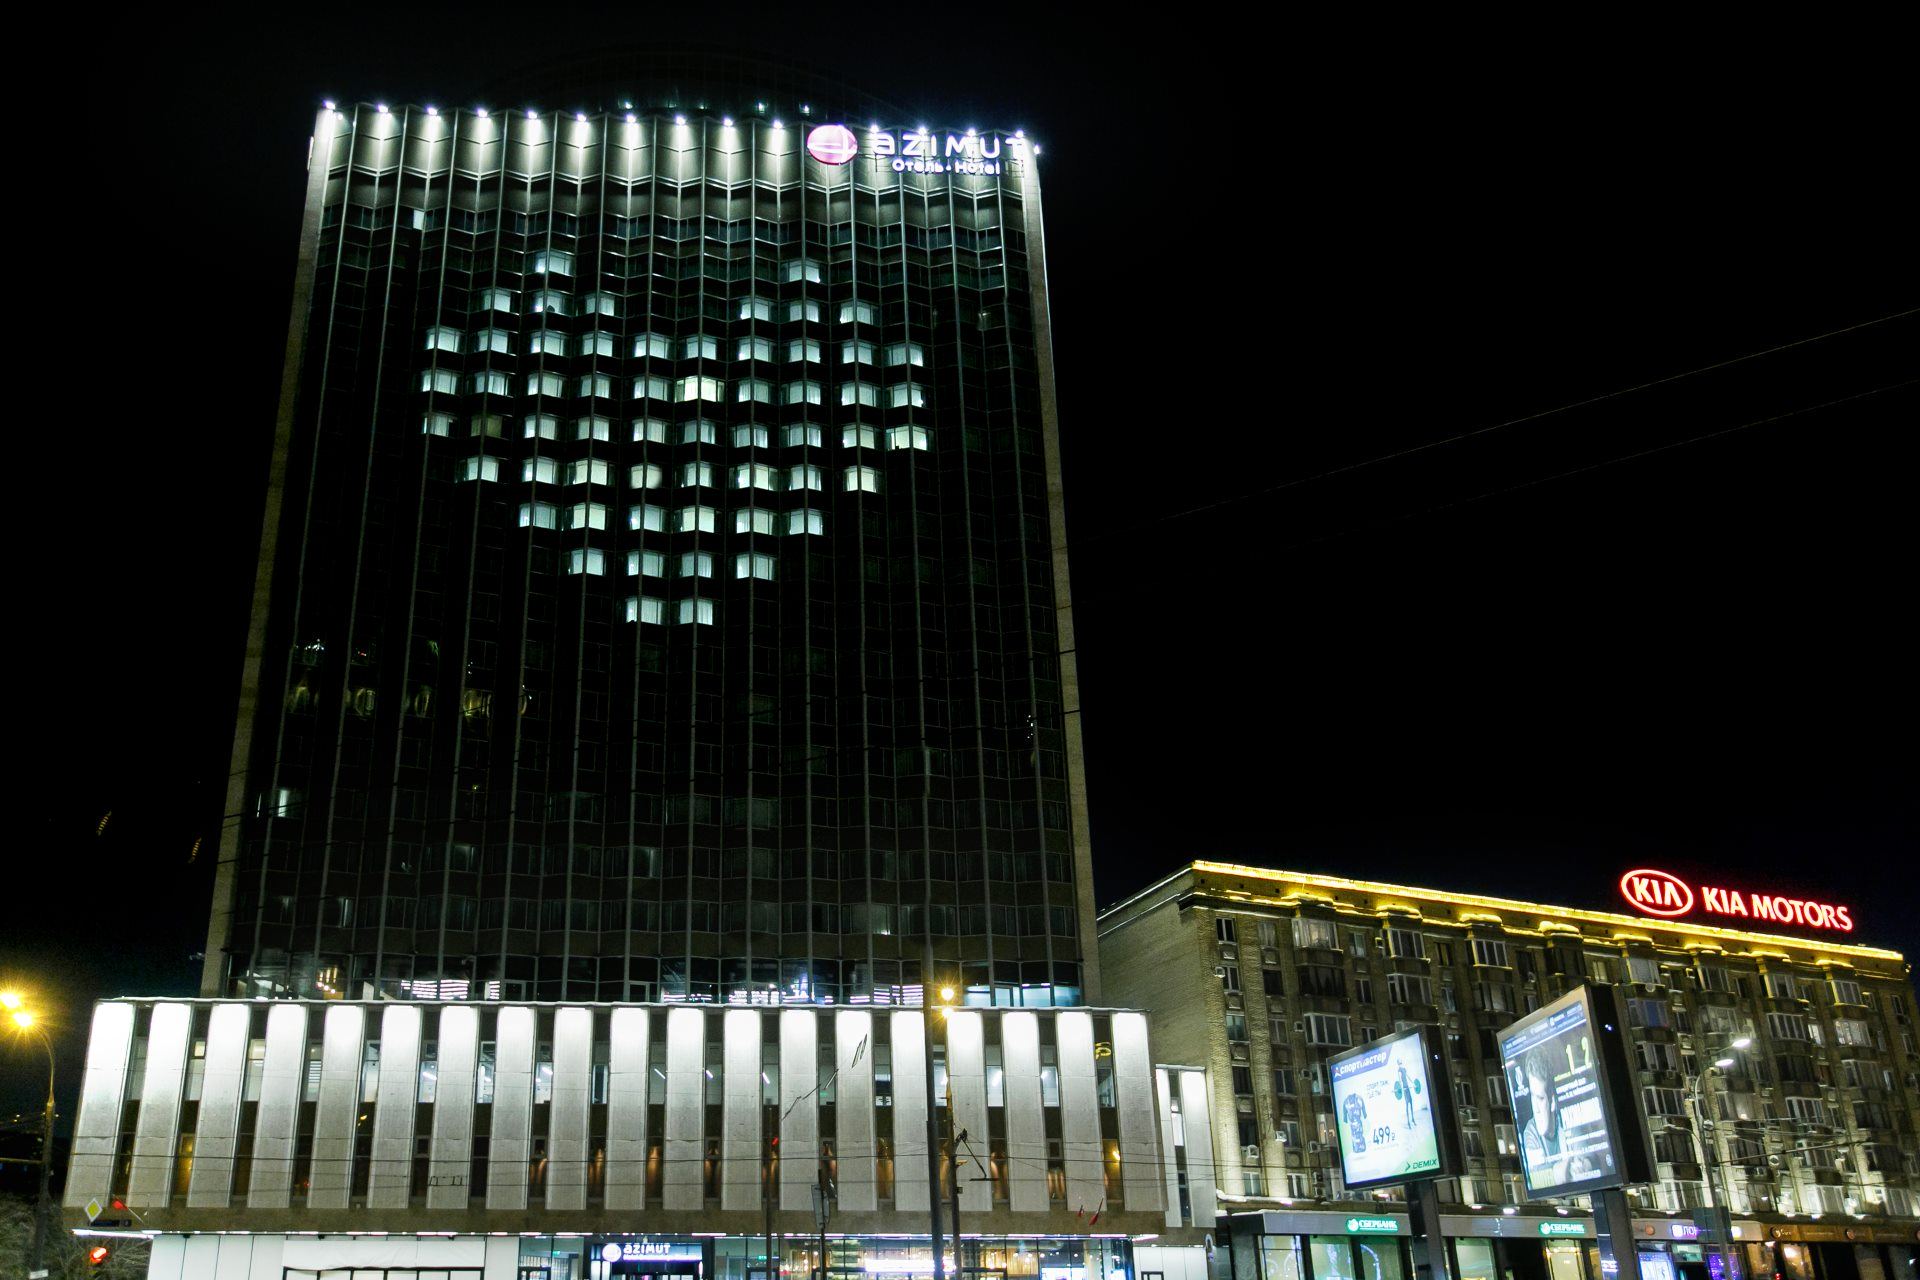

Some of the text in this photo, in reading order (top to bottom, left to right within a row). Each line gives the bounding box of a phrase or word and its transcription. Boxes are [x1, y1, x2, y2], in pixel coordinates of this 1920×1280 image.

[892, 160, 1001, 175] Отель Hotel
[1631, 876, 1683, 907] KIA
[1702, 886, 1853, 931] KIA MOTORS
[1412, 1158, 1438, 1169] DEMIX
[1358, 1219, 1398, 1230] СБЕРБАНК
[1550, 1223, 1585, 1232] СБЕРБАНК
